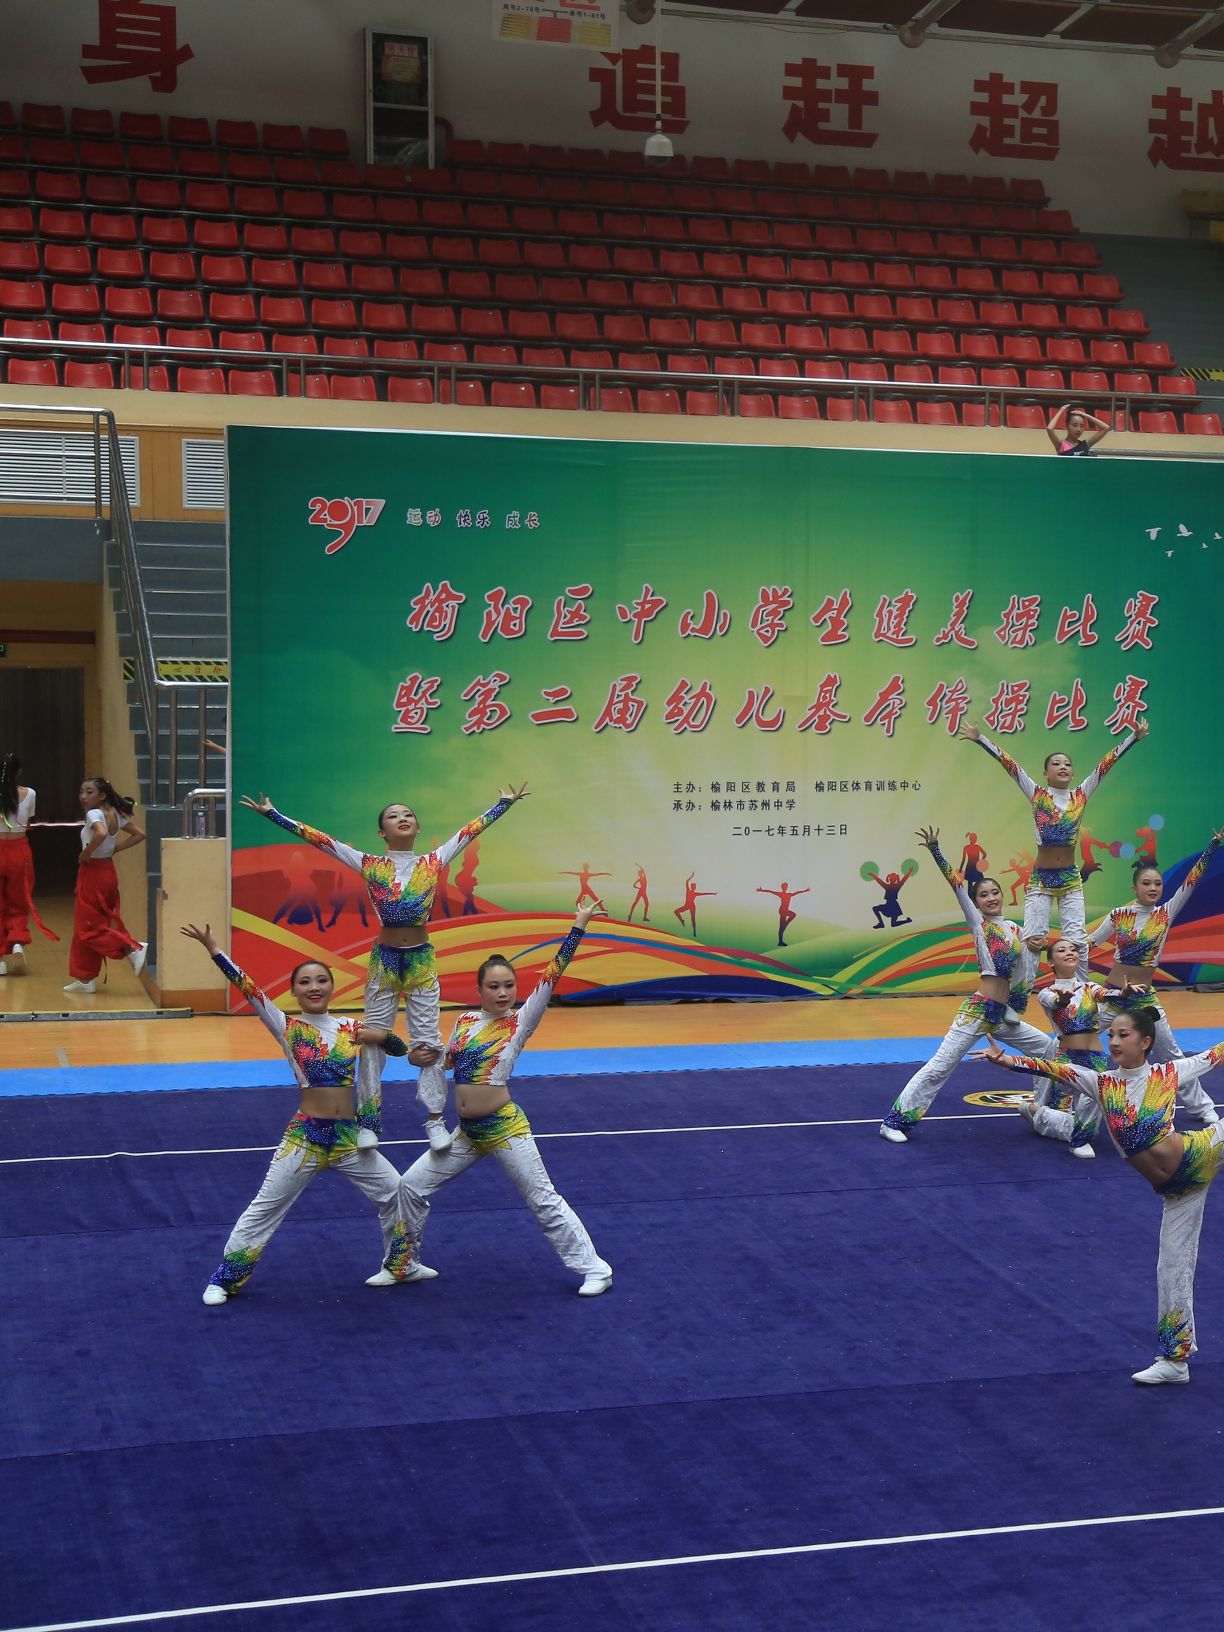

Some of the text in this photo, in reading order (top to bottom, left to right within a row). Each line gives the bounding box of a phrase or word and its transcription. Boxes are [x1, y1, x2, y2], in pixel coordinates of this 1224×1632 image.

[80, 0, 194, 93] 身
[407, 508, 540, 530] 运动 快乐 成长
[407, 580, 1160, 650] 榆阳区中小学生健美操比赛
[814, 780, 922, 793] 榆阳区体育训练中心
